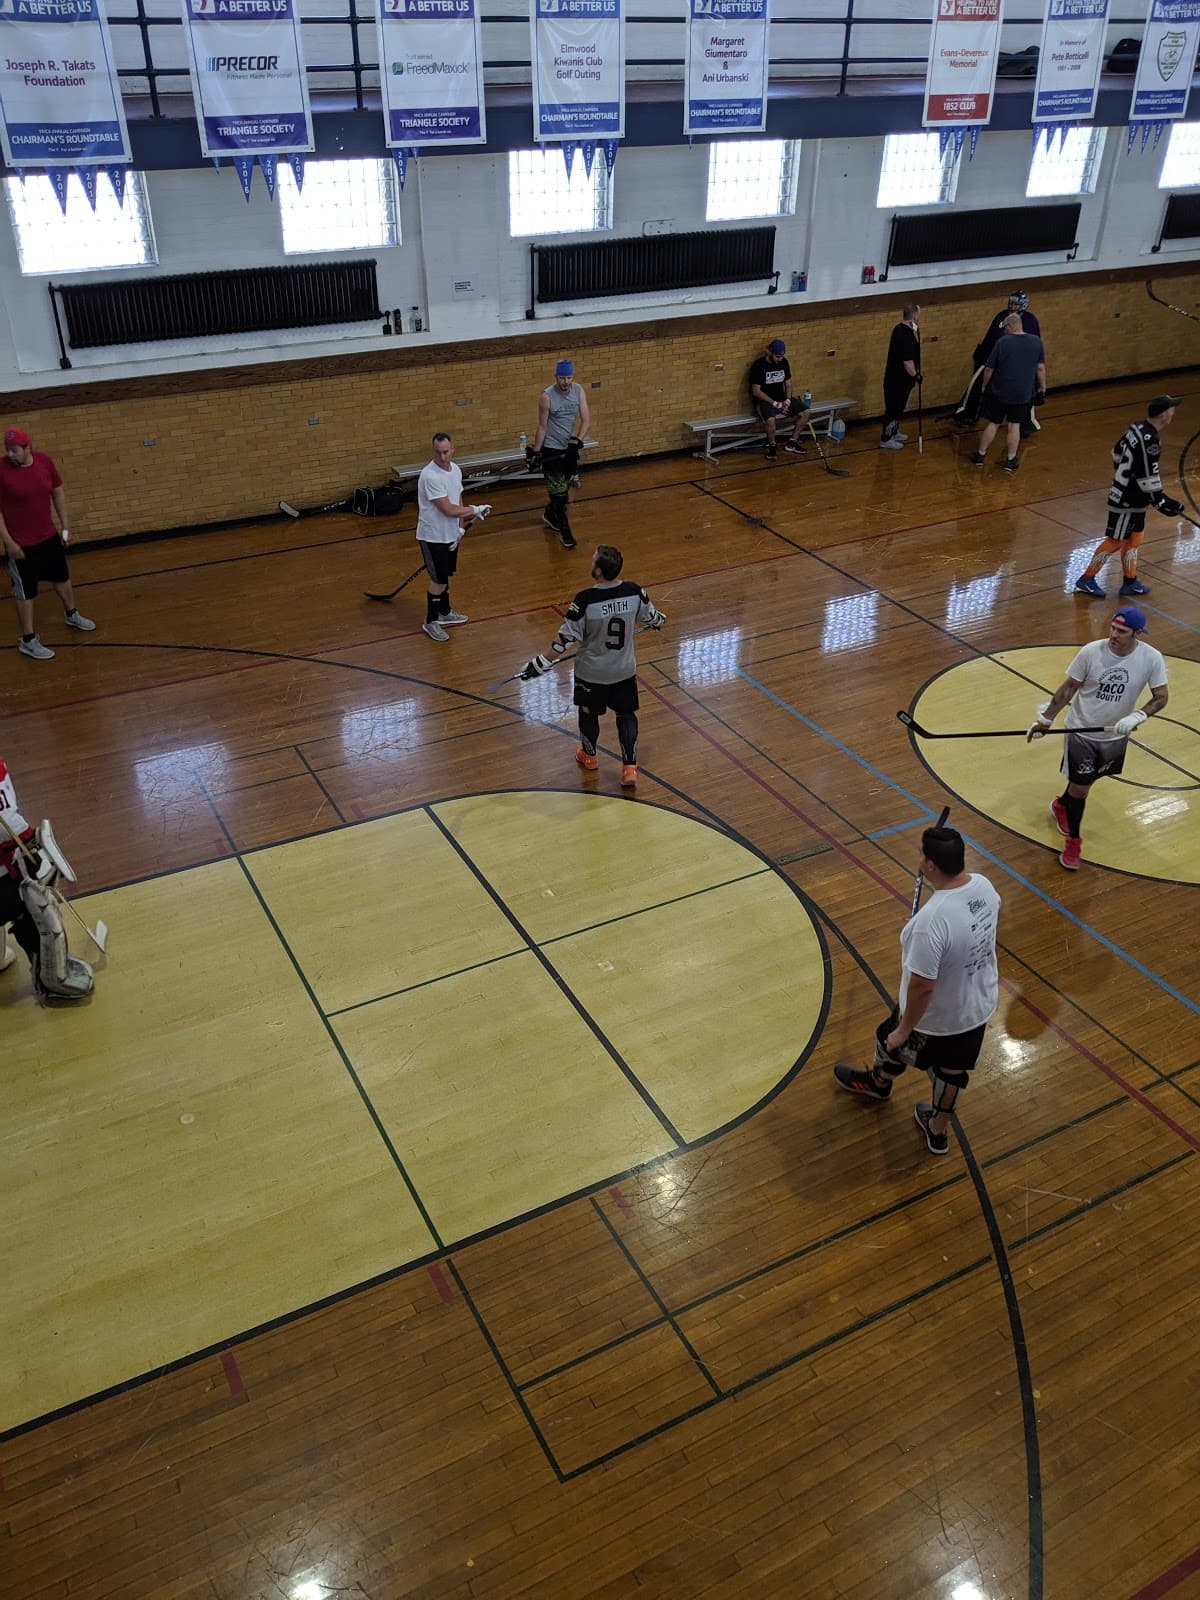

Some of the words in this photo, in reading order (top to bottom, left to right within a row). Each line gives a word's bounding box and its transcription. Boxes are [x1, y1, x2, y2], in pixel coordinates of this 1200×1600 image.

[19, 3, 28, 13] A
[30, 2, 76, 15] BETTER
[76, 1, 92, 13] US
[219, 1, 228, 12] A
[230, 0, 271, 12] BETTER
[273, 0, 287, 11] US
[409, 1, 417, 11] A
[418, 1, 455, 11] BETTER
[456, 1, 470, 11] US
[561, 2, 569, 11] A
[570, 2, 602, 11] BETTER
[603, 2, 616, 11] US
[714, 4, 720, 13] A
[721, 3, 751, 13] BETTER
[752, 3, 763, 12] US
[957, 7, 962, 15] A
[962, 6, 988, 15] BETTER
[988, 6, 997, 15] US
[1065, 6, 1070, 14] A
[1070, 5, 1094, 14] BETTER
[1095, 4, 1104, 13] US
[710, 37, 745, 48] Margaret
[560, 44, 596, 53] Elmwood
[705, 49, 748, 58] Giumentaro
[6, 58, 45, 73] Joseph
[48, 60, 60, 71] R.
[62, 59, 96, 72] Takats
[216, 56, 279, 71] PRECOR
[554, 57, 584, 66] Kiwanis
[586, 57, 603, 66] Club
[722, 61, 728, 70] &
[950, 60, 978, 68] Memorial
[407, 61, 468, 75] FreedMaxick
[556, 70, 573, 79] Golf
[574, 70, 601, 80] Outing
[702, 73, 715, 82] Ani
[716, 73, 749, 83] Urbanski
[24, 75, 86, 87] Foundation
[541, 113, 578, 122] CHAIRMAN'S
[579, 112, 618, 121] ROUNDTABLE
[691, 108, 724, 117] CHAIRMAN'S
[725, 107, 761, 116] ROUNDTABLE
[400, 118, 438, 128] TRIANGLE
[438, 117, 470, 127] SOCIETY
[217, 127, 259, 137] TRIANGLE
[260, 124, 295, 135] SOCIETY
[11, 135, 65, 145] CHAIRMAN'S
[66, 133, 120, 144] ROUNDTABLE
[266, 160, 274, 192] 2017
[1151, 461, 1160, 474] 2
[602, 600, 629, 616] SMITH
[605, 617, 626, 651] 9
[1099, 682, 1125, 695] TACO
[1114, 694, 1122, 703] IT
